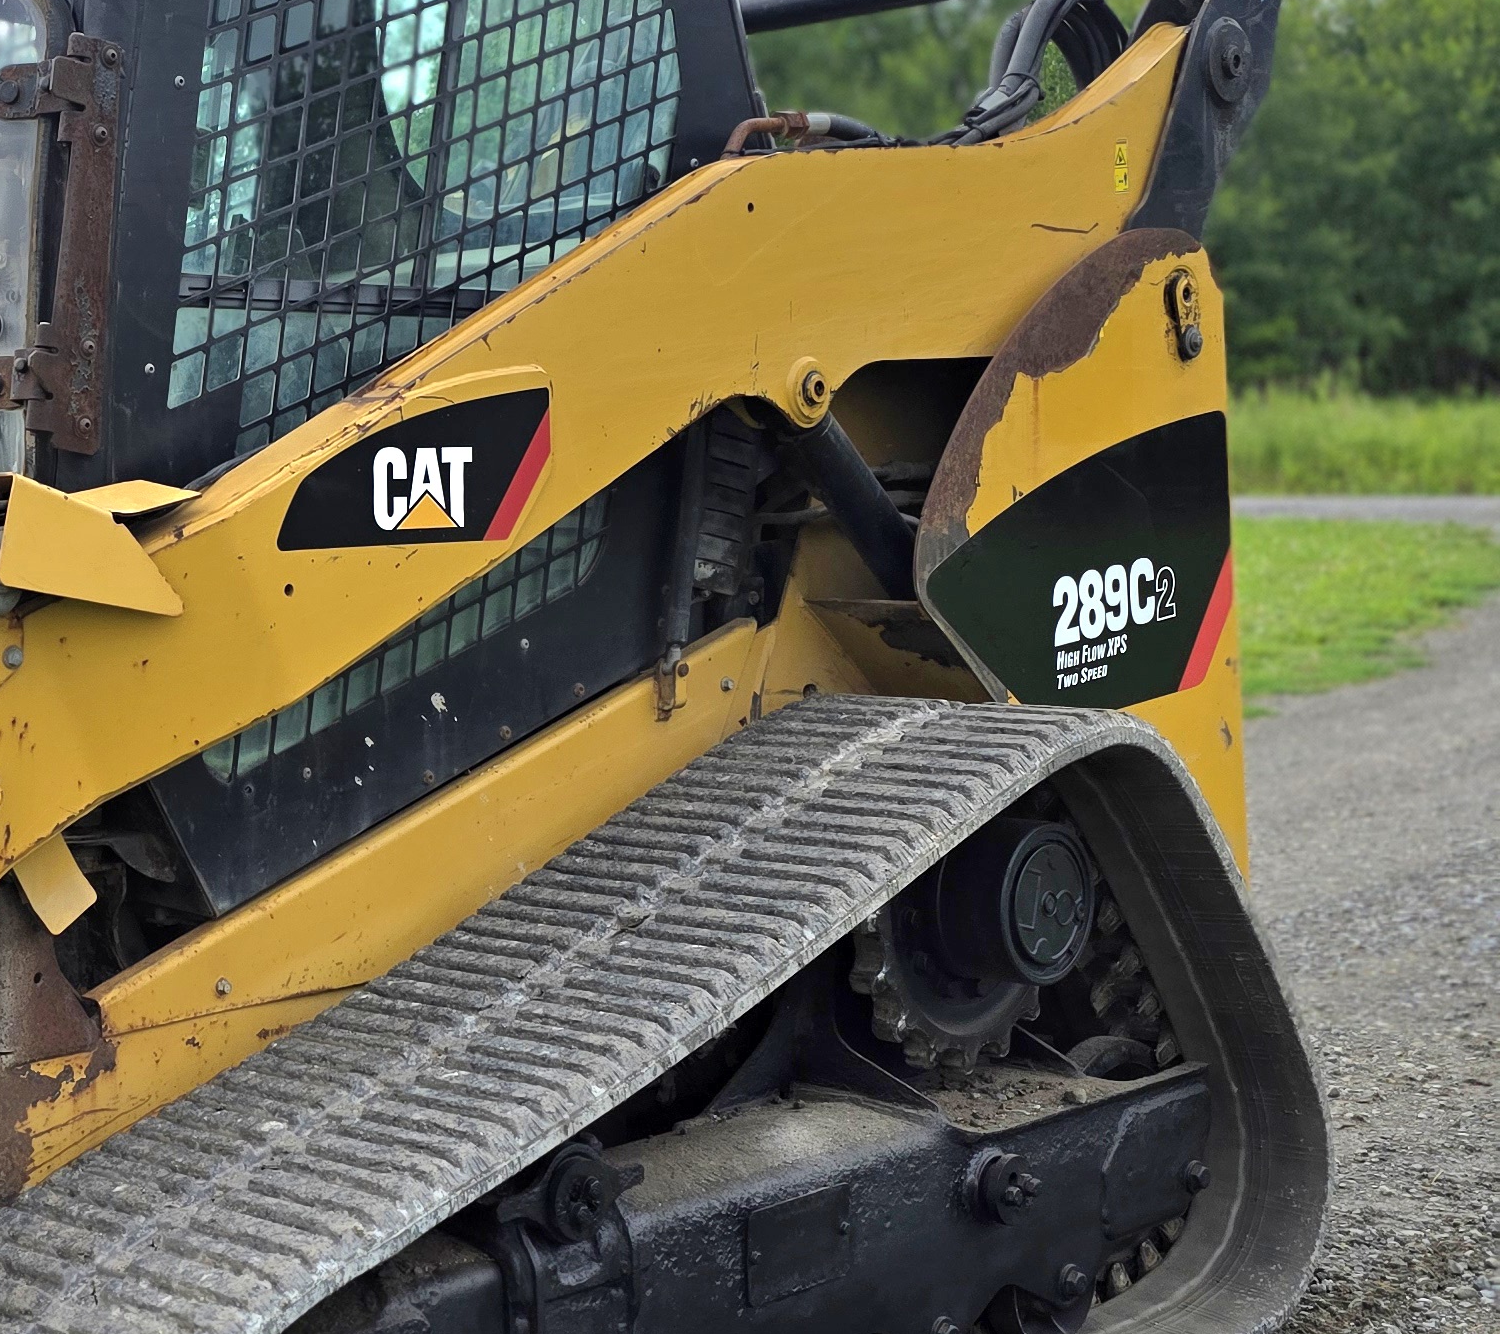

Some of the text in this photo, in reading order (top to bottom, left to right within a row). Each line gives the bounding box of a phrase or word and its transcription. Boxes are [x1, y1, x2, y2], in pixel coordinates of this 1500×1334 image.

[373, 446, 473, 531] CAT
[1052, 557, 1177, 647] 289C2
[1107, 633, 1128, 658] XPS
